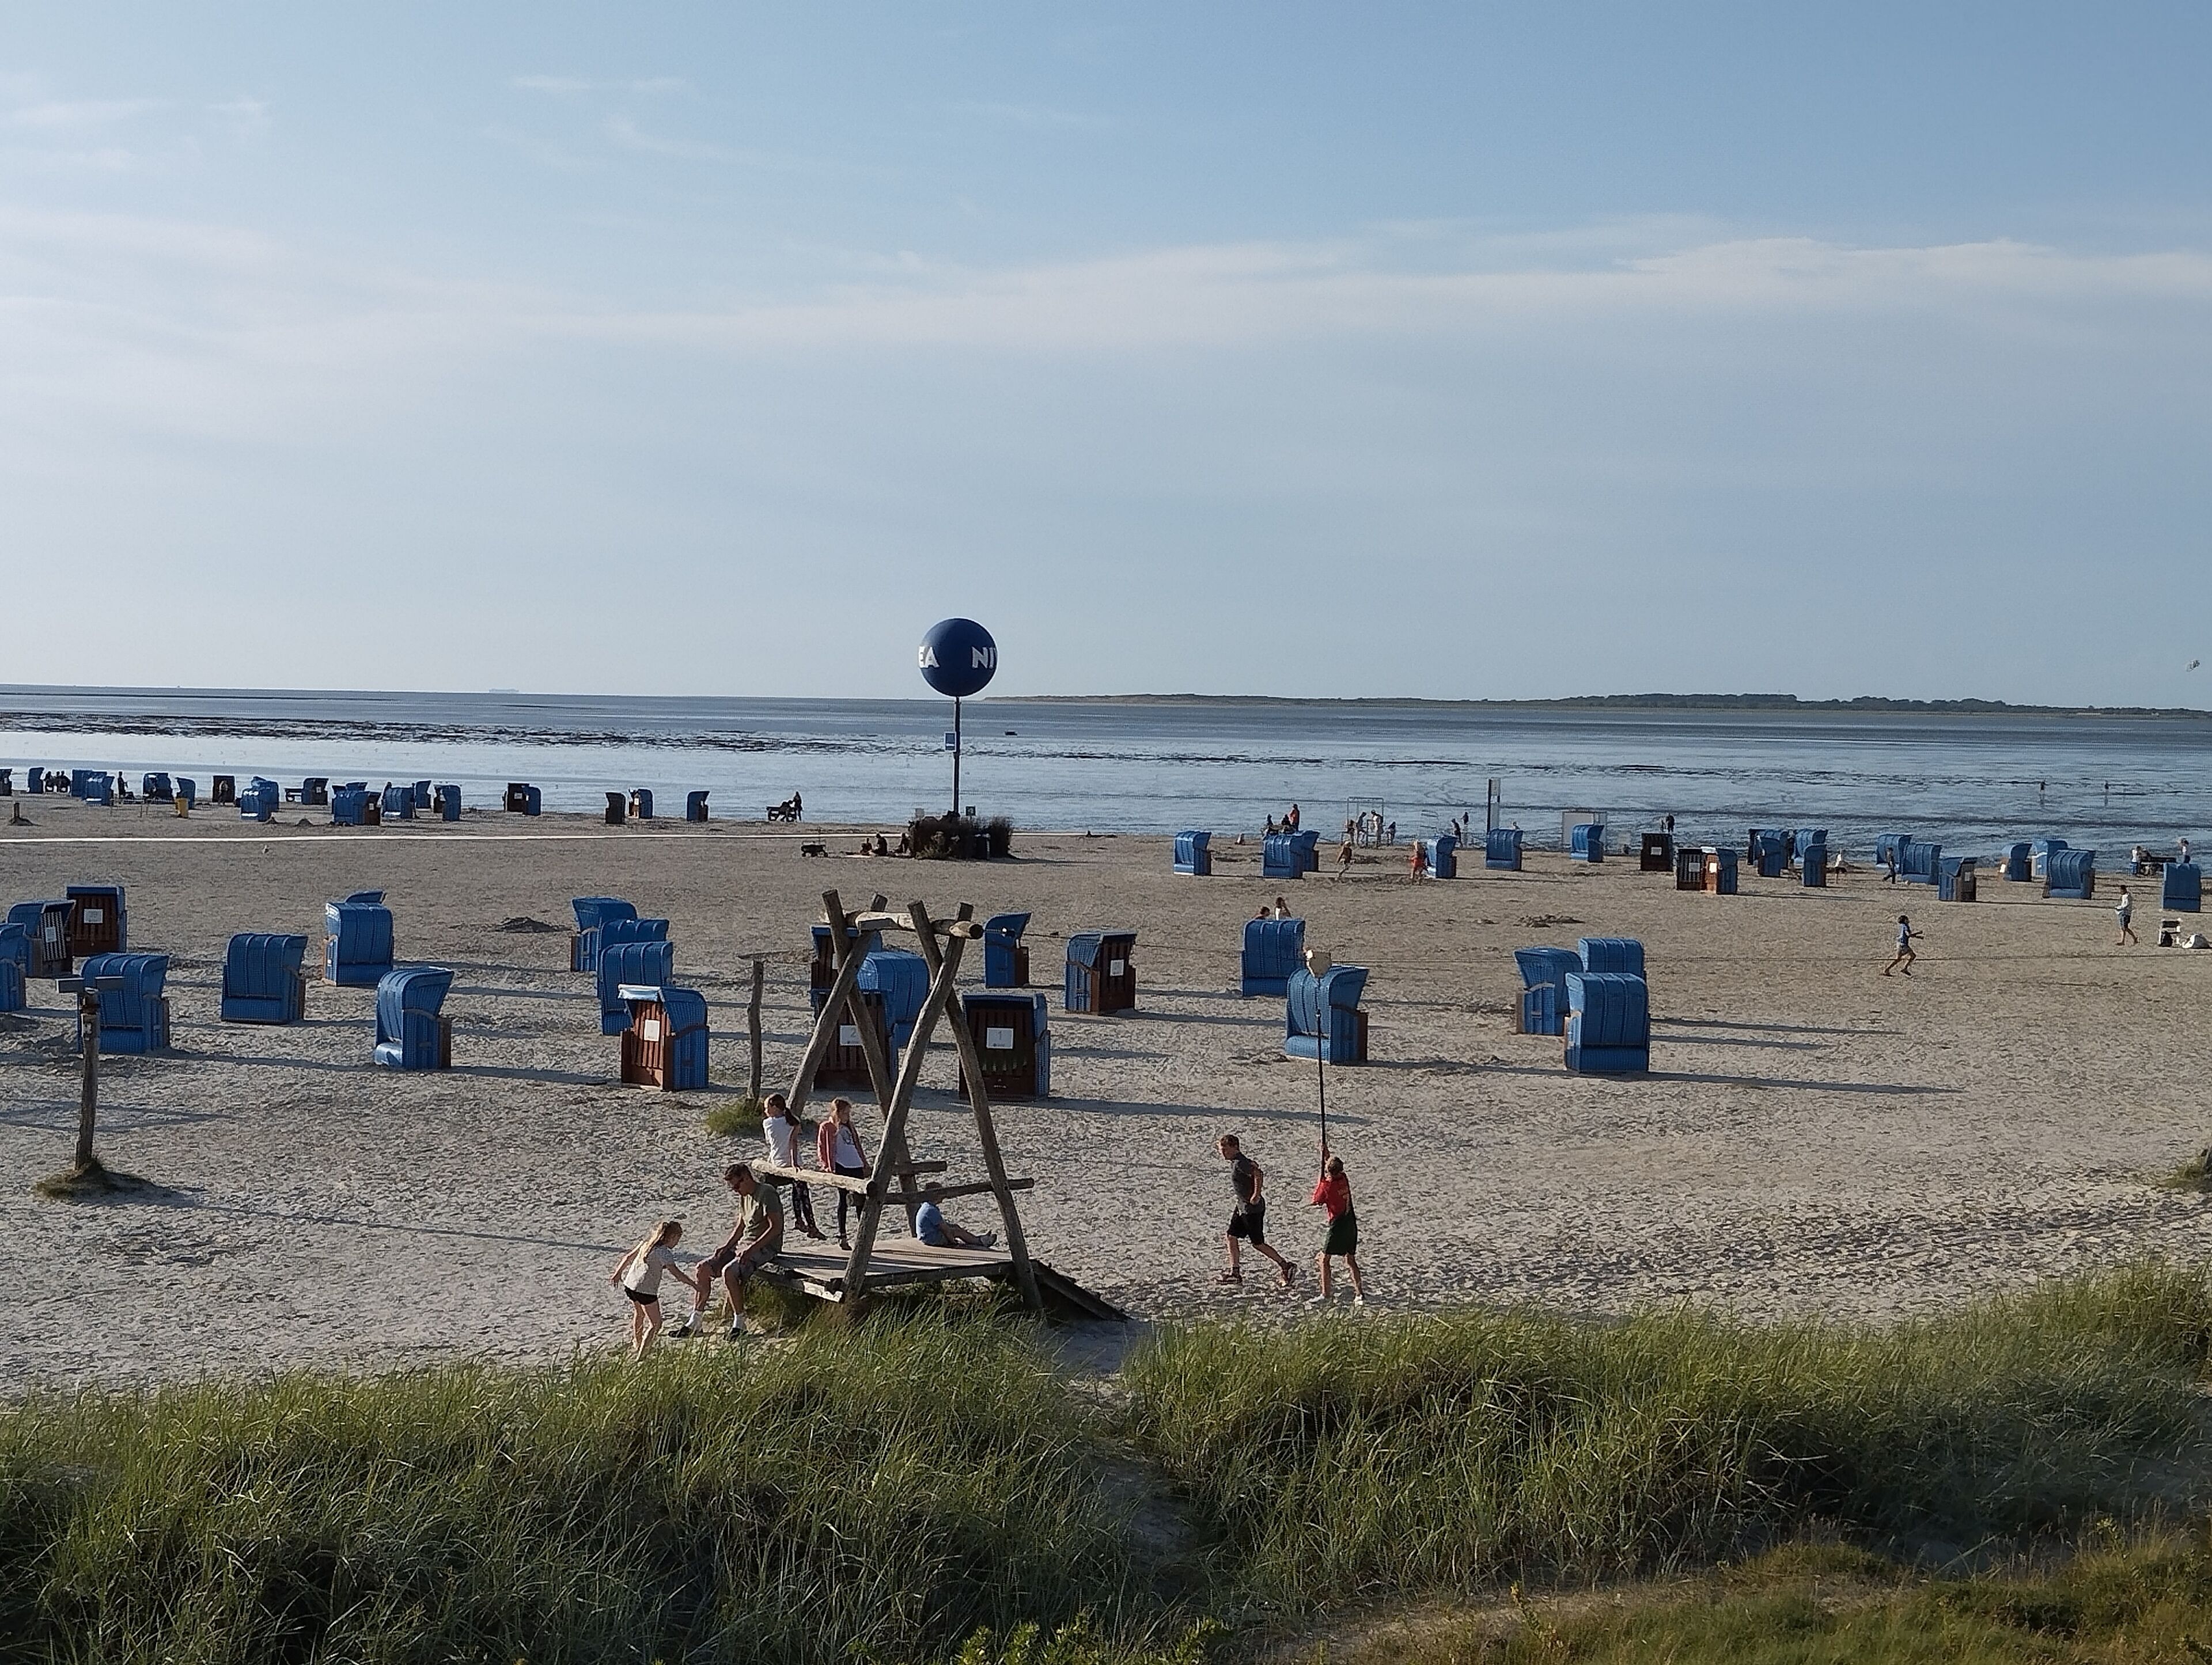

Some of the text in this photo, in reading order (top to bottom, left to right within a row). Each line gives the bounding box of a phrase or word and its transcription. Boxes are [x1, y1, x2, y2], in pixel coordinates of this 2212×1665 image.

[972, 647, 997, 669] NI
[850, 1027, 857, 1037] 2
[997, 1030, 1002, 1040] 1
